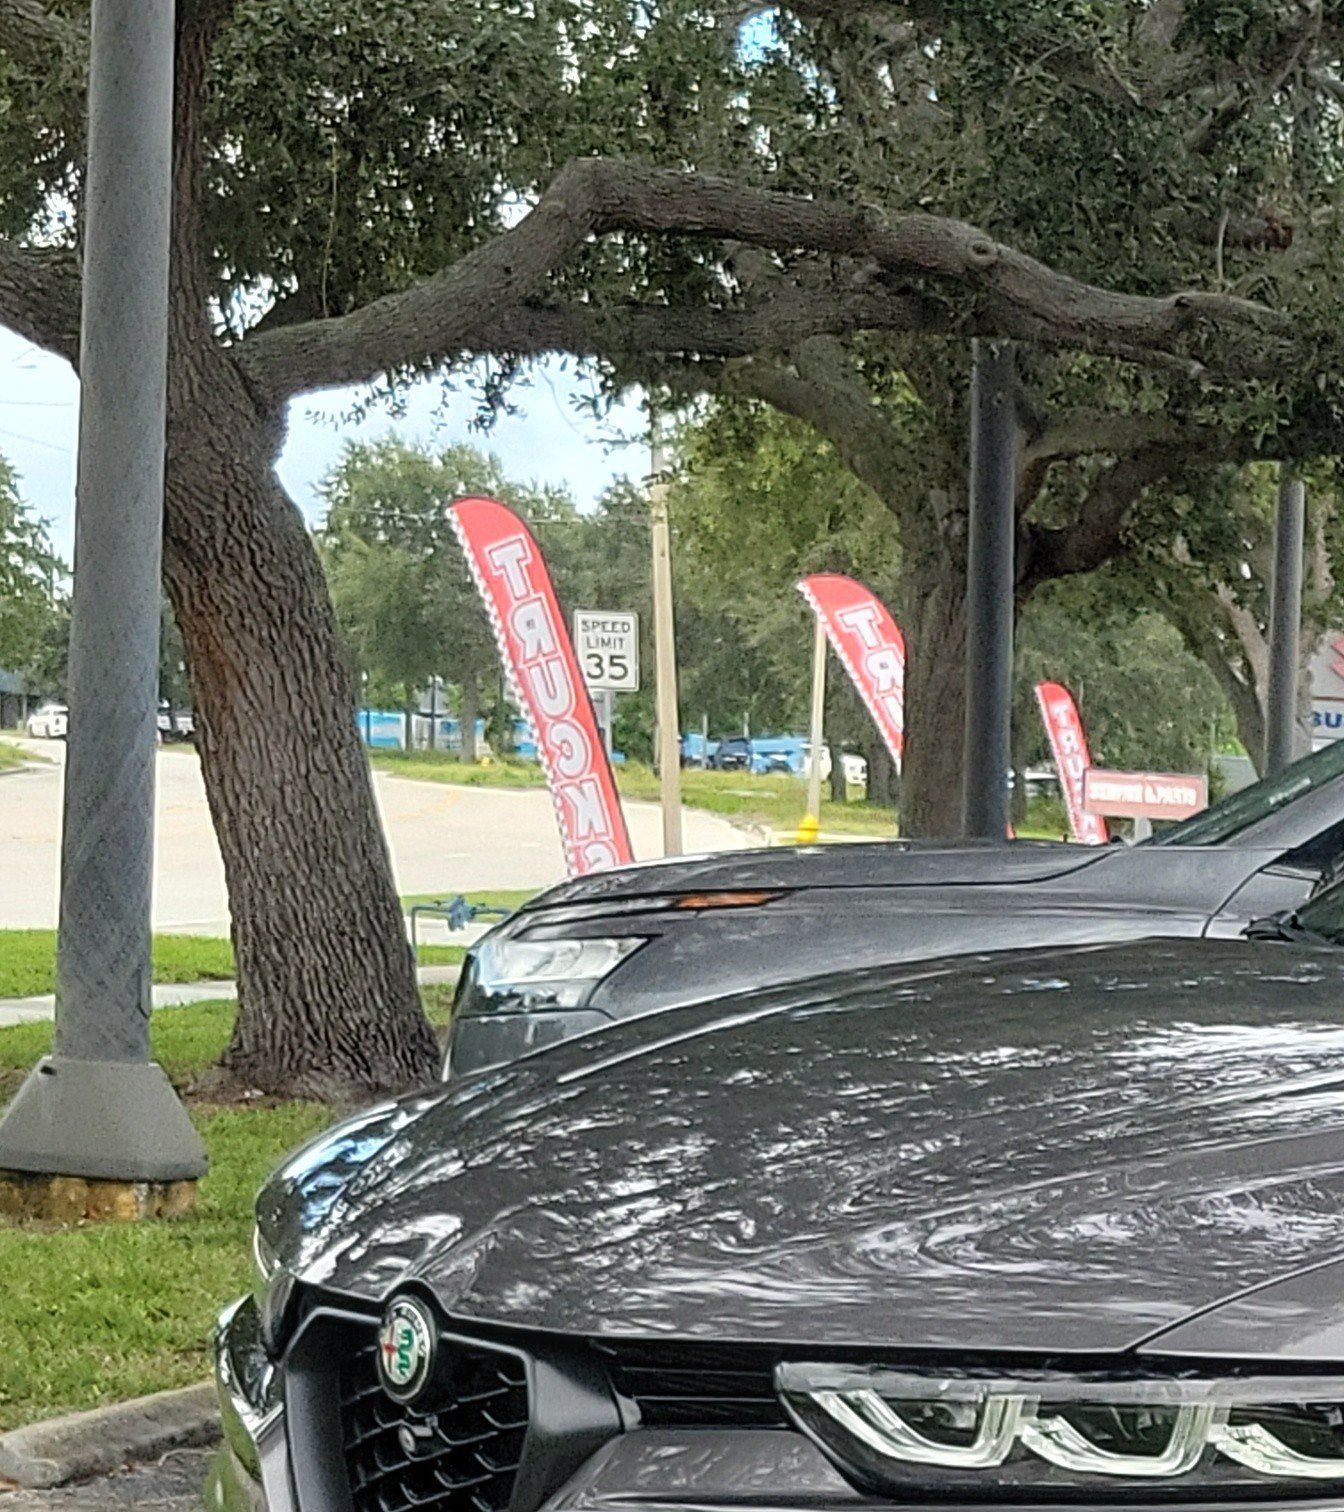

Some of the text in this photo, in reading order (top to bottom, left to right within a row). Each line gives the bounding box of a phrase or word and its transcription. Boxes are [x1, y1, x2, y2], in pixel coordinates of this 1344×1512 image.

[581, 619, 631, 634] SPEED
[586, 636, 625, 650] LIMIT
[586, 653, 629, 681] 35
